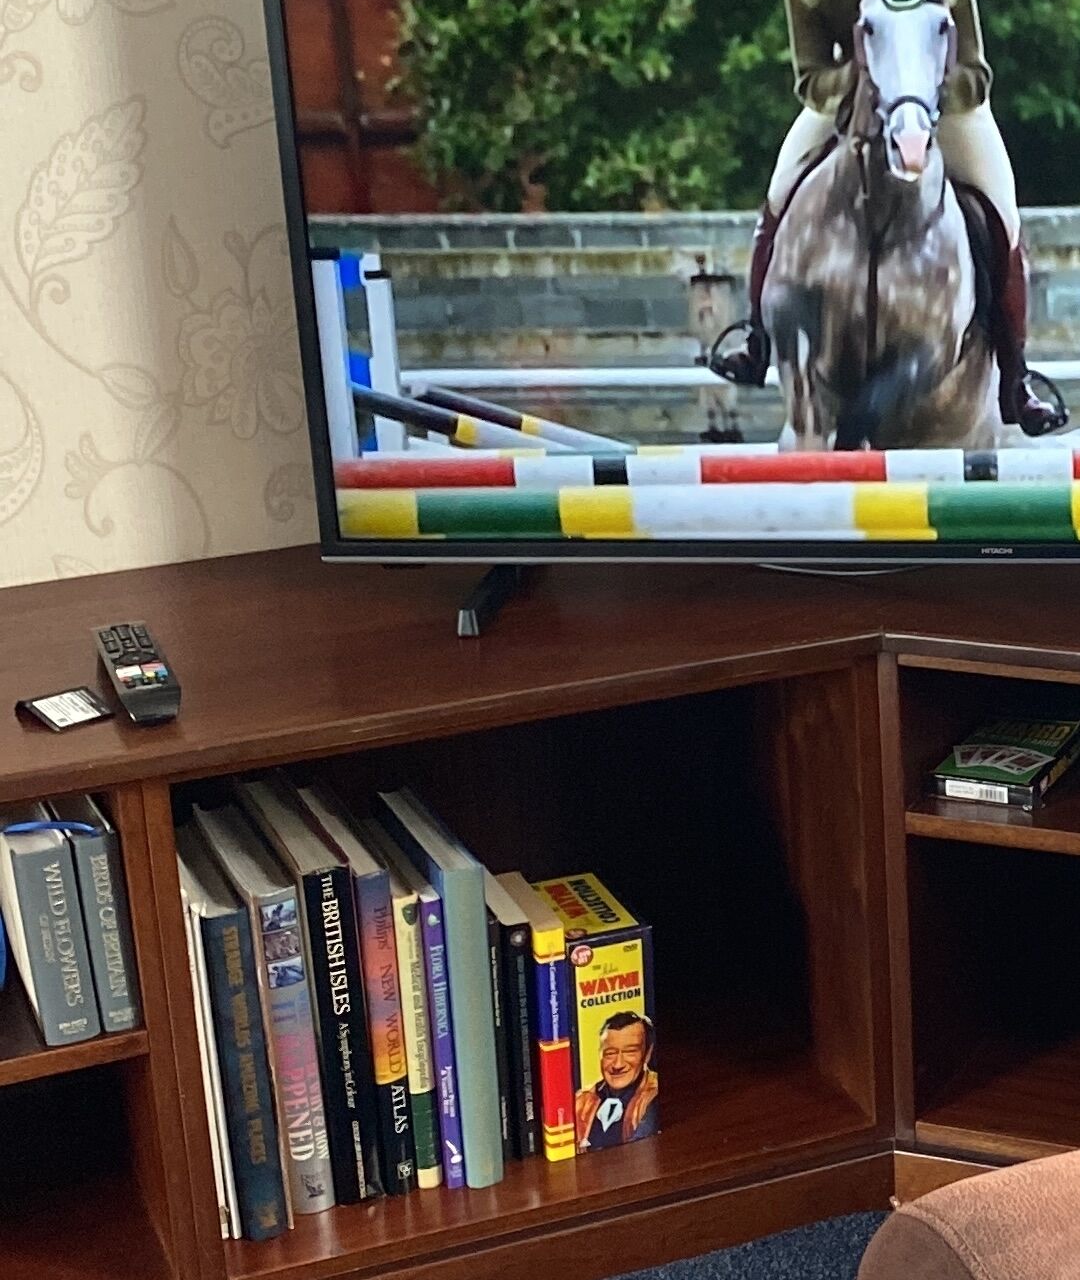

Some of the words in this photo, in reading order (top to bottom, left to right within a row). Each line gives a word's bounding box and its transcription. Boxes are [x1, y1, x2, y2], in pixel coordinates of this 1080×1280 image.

[981, 547, 1013, 555] HITACHI
[43, 860, 67, 916] WILD
[90, 853, 114, 904] BIRDS
[320, 875, 334, 899] THE
[99, 906, 118, 930] OF
[321, 898, 346, 968] BRITISH
[53, 917, 84, 1007] FLOWERS
[102, 930, 129, 998] BRITAIN
[380, 963, 396, 1002] NEW
[430, 944, 444, 980] FLORA
[579, 970, 640, 997] WAYNE
[329, 969, 350, 1016] ISLES
[433, 981, 449, 1039] HIBERNICA
[581, 988, 641, 1008] COLLECTION
[385, 1011, 403, 1074] WORLD
[390, 1085, 409, 1134] ATLAS
